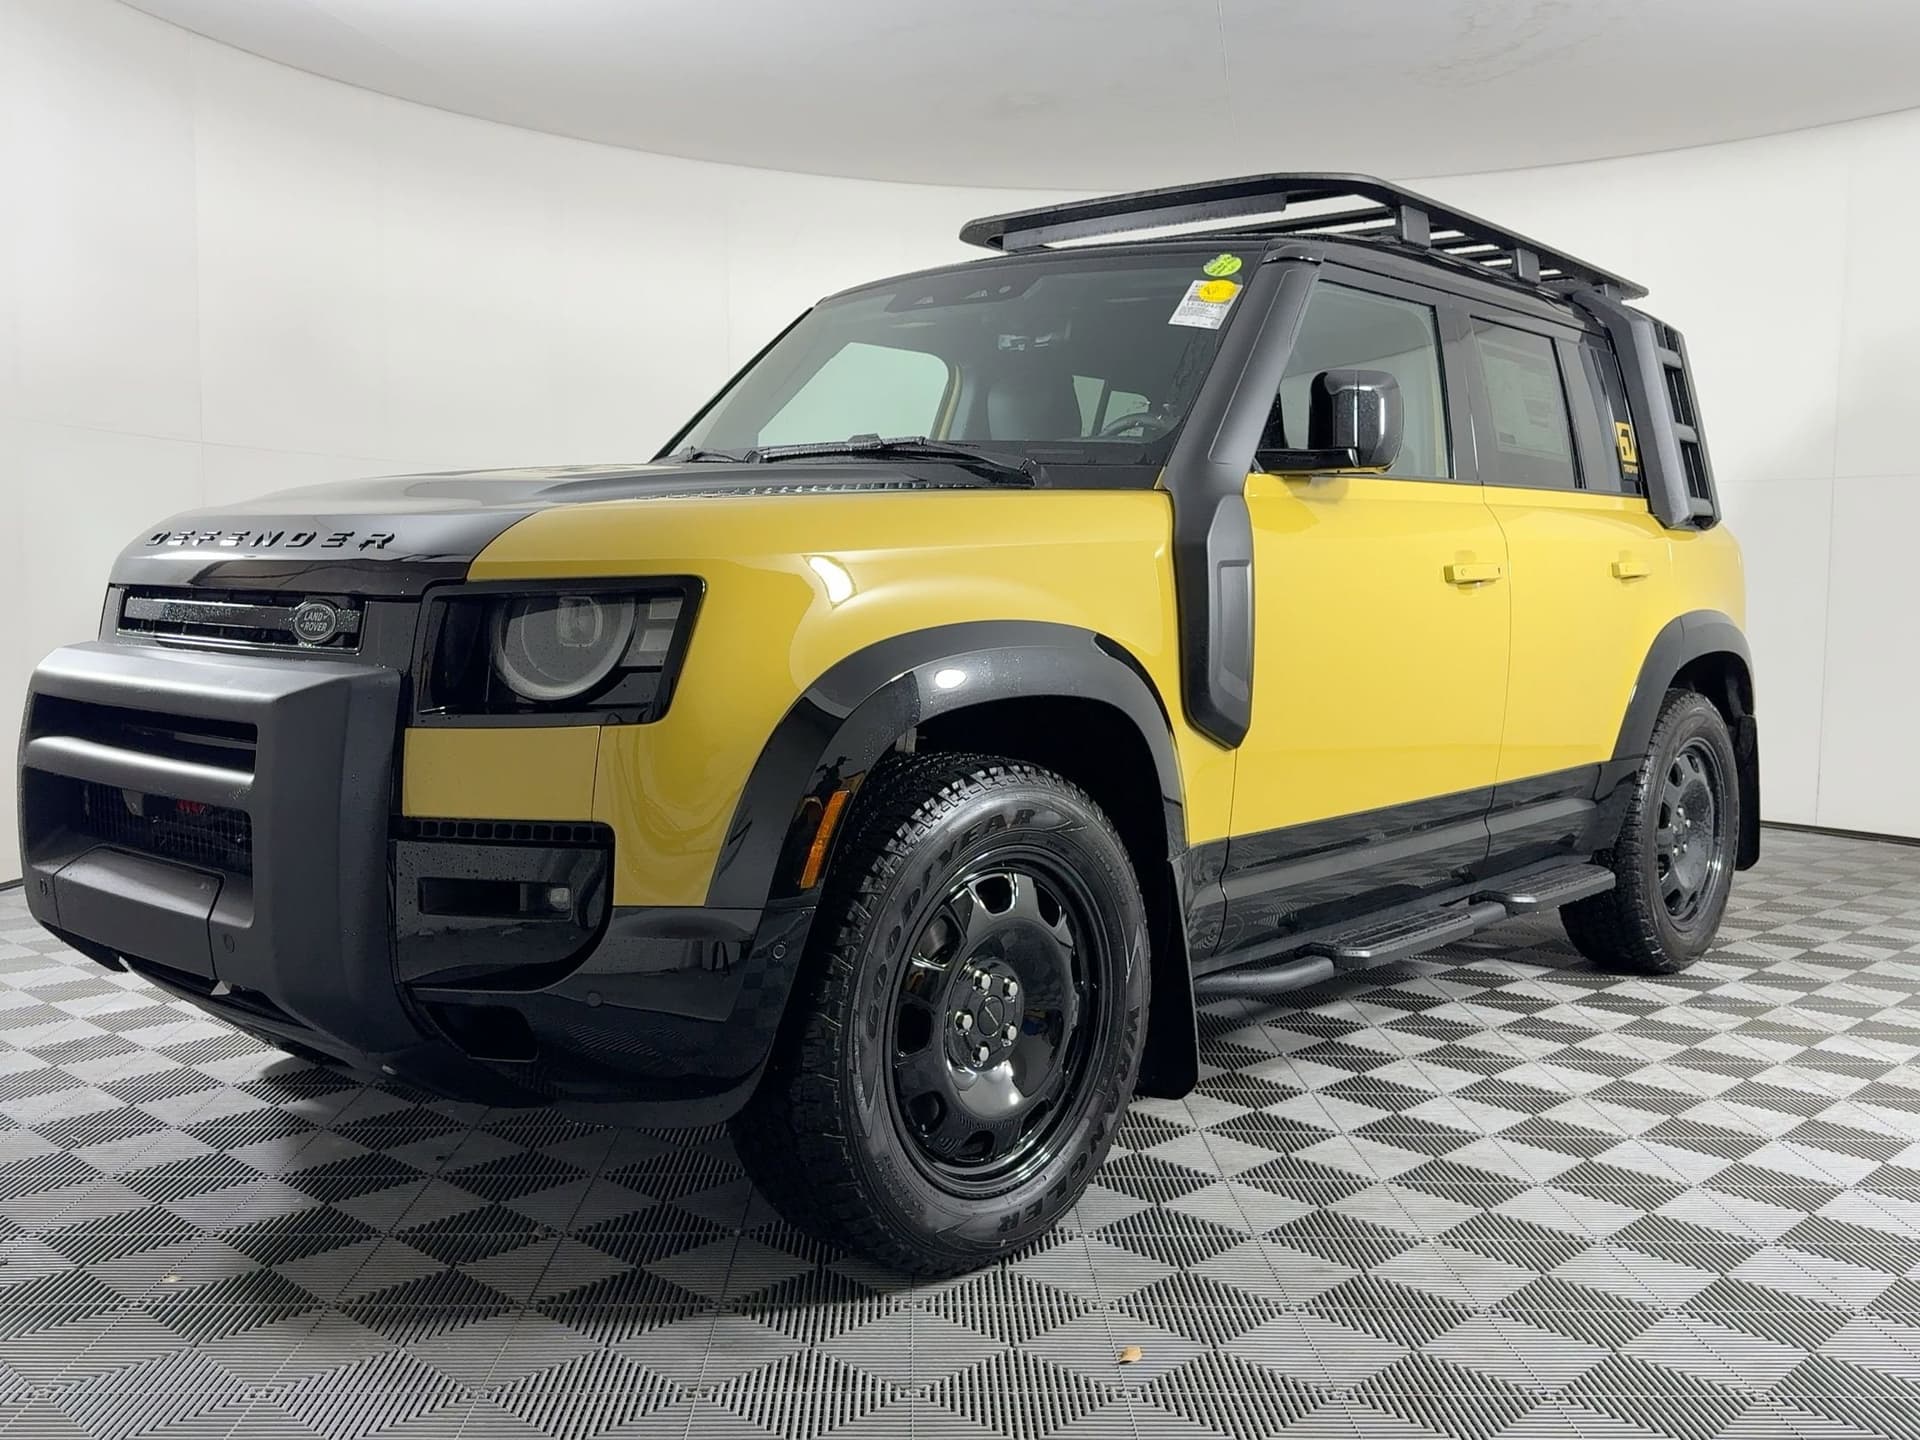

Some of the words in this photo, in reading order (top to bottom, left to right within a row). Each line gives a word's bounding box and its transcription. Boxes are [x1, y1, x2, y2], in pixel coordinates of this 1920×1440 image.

[145, 531, 395, 551] DEFENDER
[303, 611, 324, 621] LAND
[303, 621, 328, 632] ROVER
[866, 808, 1036, 1041] GOODYEAR
